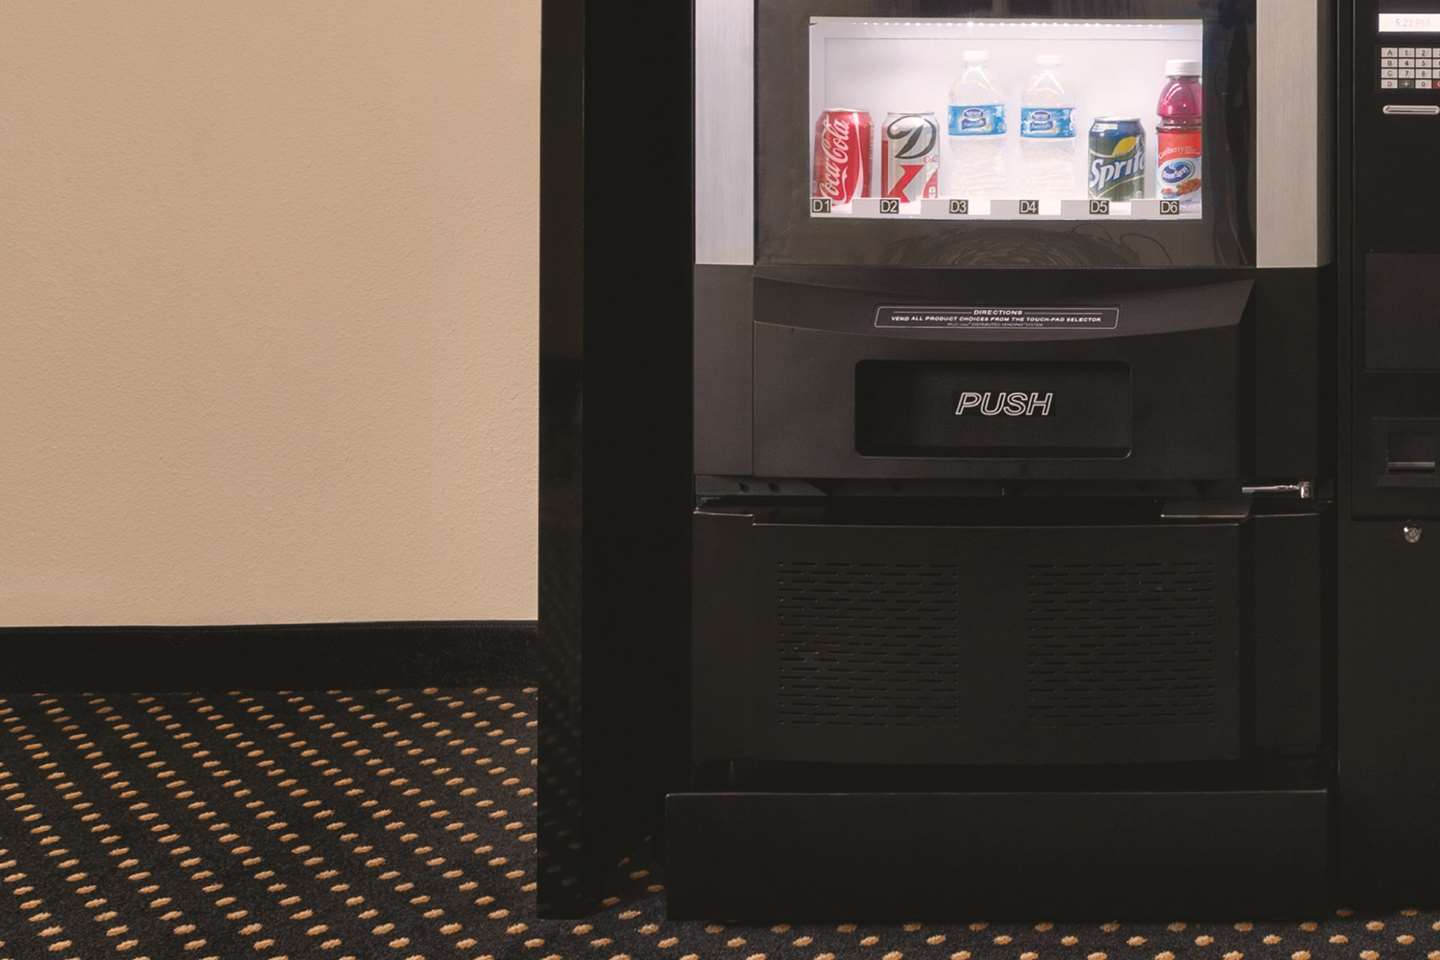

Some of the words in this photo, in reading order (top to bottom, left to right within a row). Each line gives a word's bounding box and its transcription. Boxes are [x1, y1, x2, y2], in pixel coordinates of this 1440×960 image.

[813, 200, 831, 212] D1
[881, 201, 898, 213] D2
[950, 201, 967, 213] D3
[1020, 201, 1037, 213] D4
[1090, 201, 1108, 213] D5
[1161, 201, 1178, 213] D6
[955, 392, 1053, 416] PUSH
